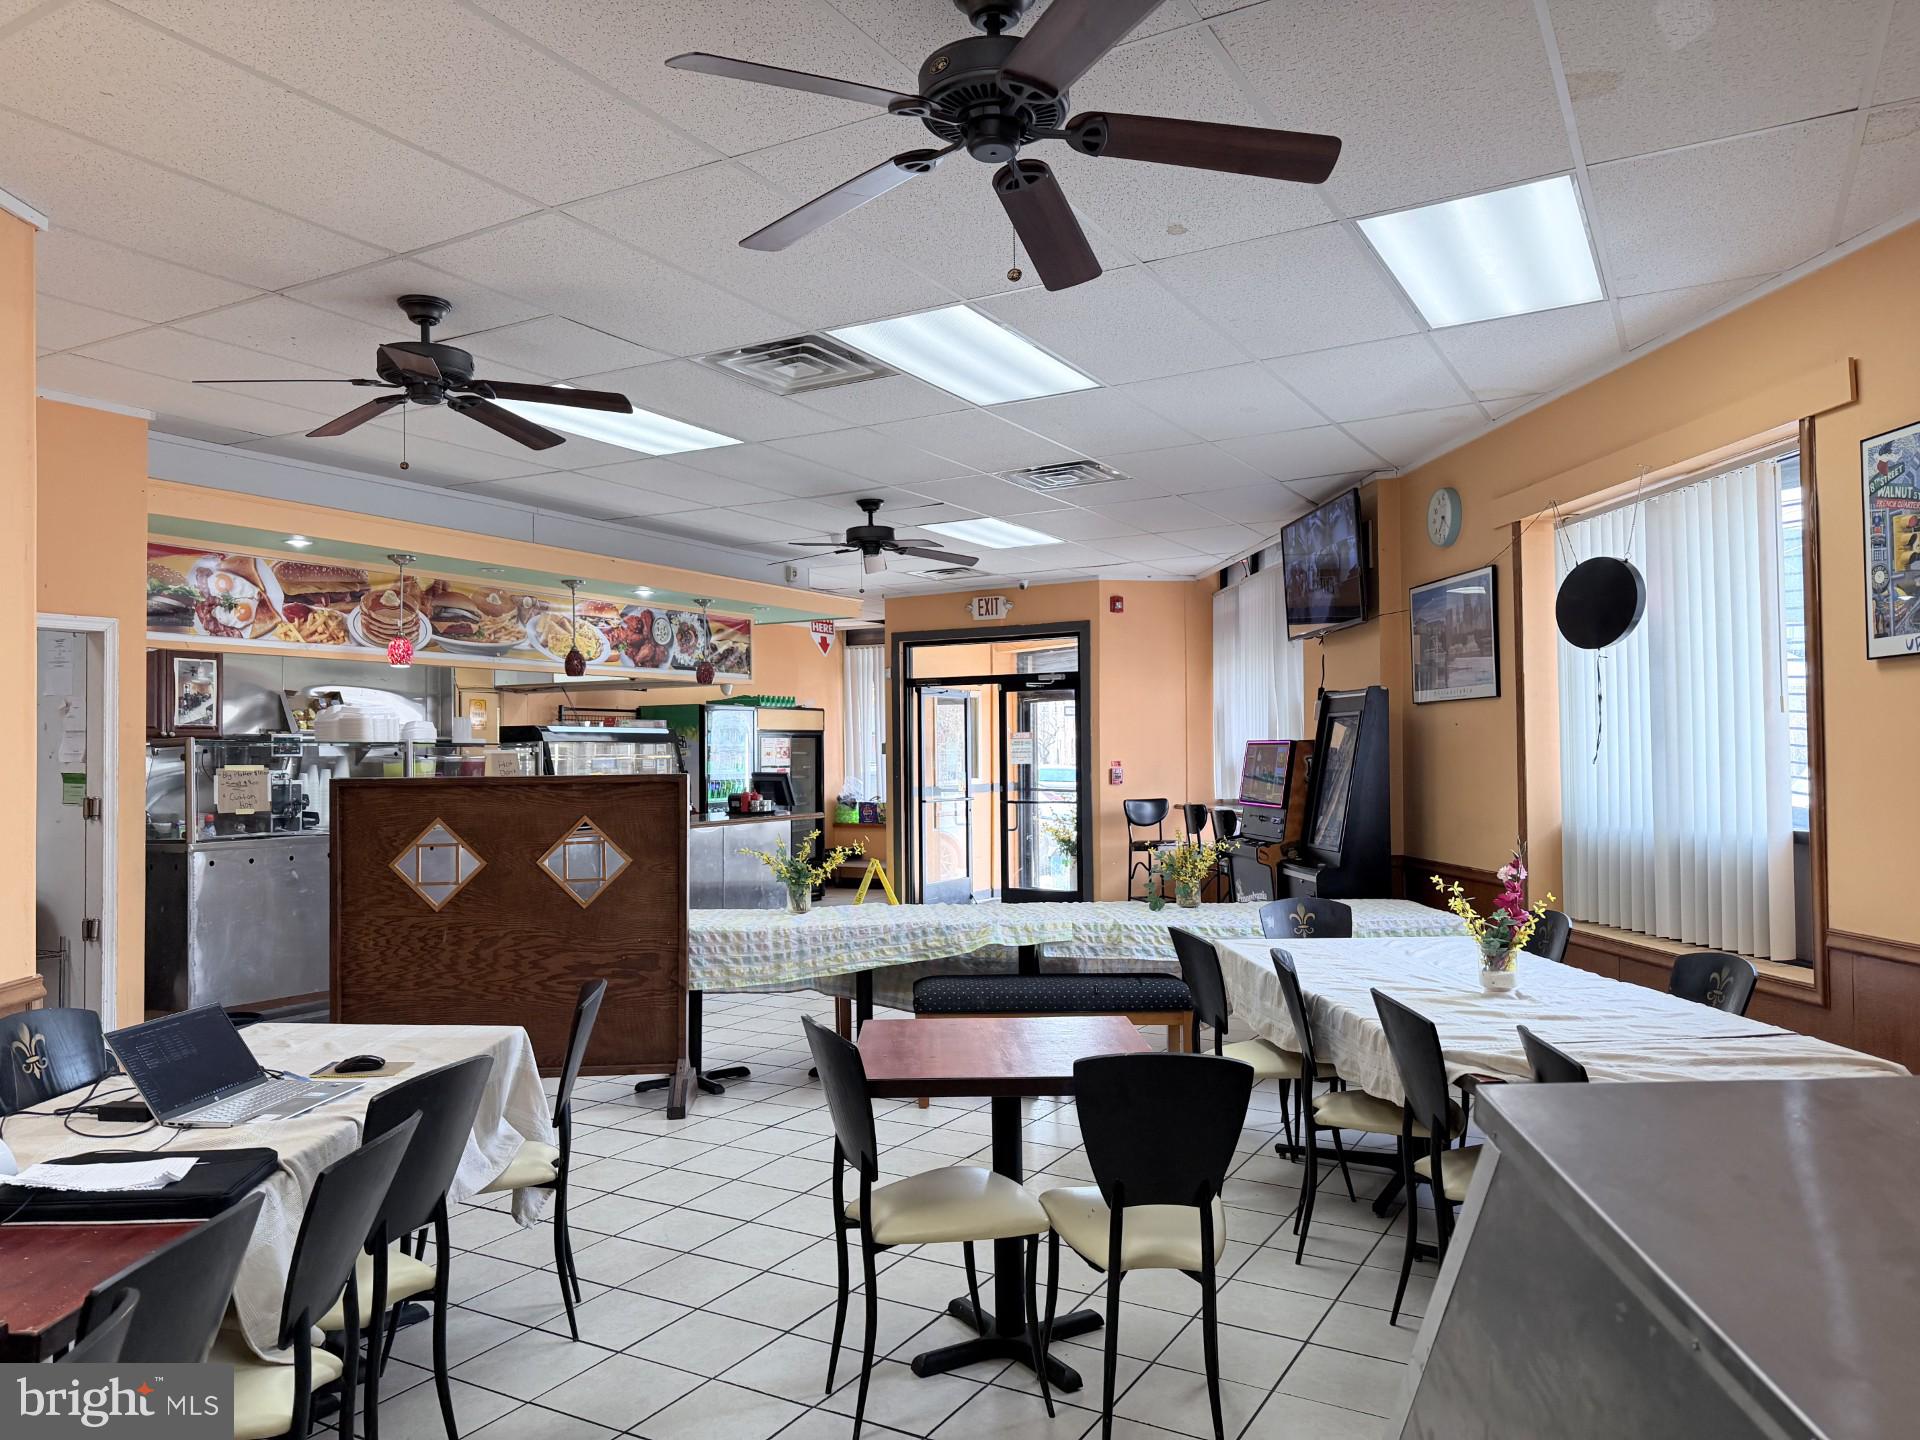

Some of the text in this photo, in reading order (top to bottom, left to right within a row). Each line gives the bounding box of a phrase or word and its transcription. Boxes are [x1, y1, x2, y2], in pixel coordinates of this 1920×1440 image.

[1880, 465, 1904, 486] STREET
[1877, 485, 1914, 499] WALNUT
[1876, 500, 1897, 508] FRENCH
[977, 597, 1000, 617] EXIT
[812, 622, 833, 633] HERE
